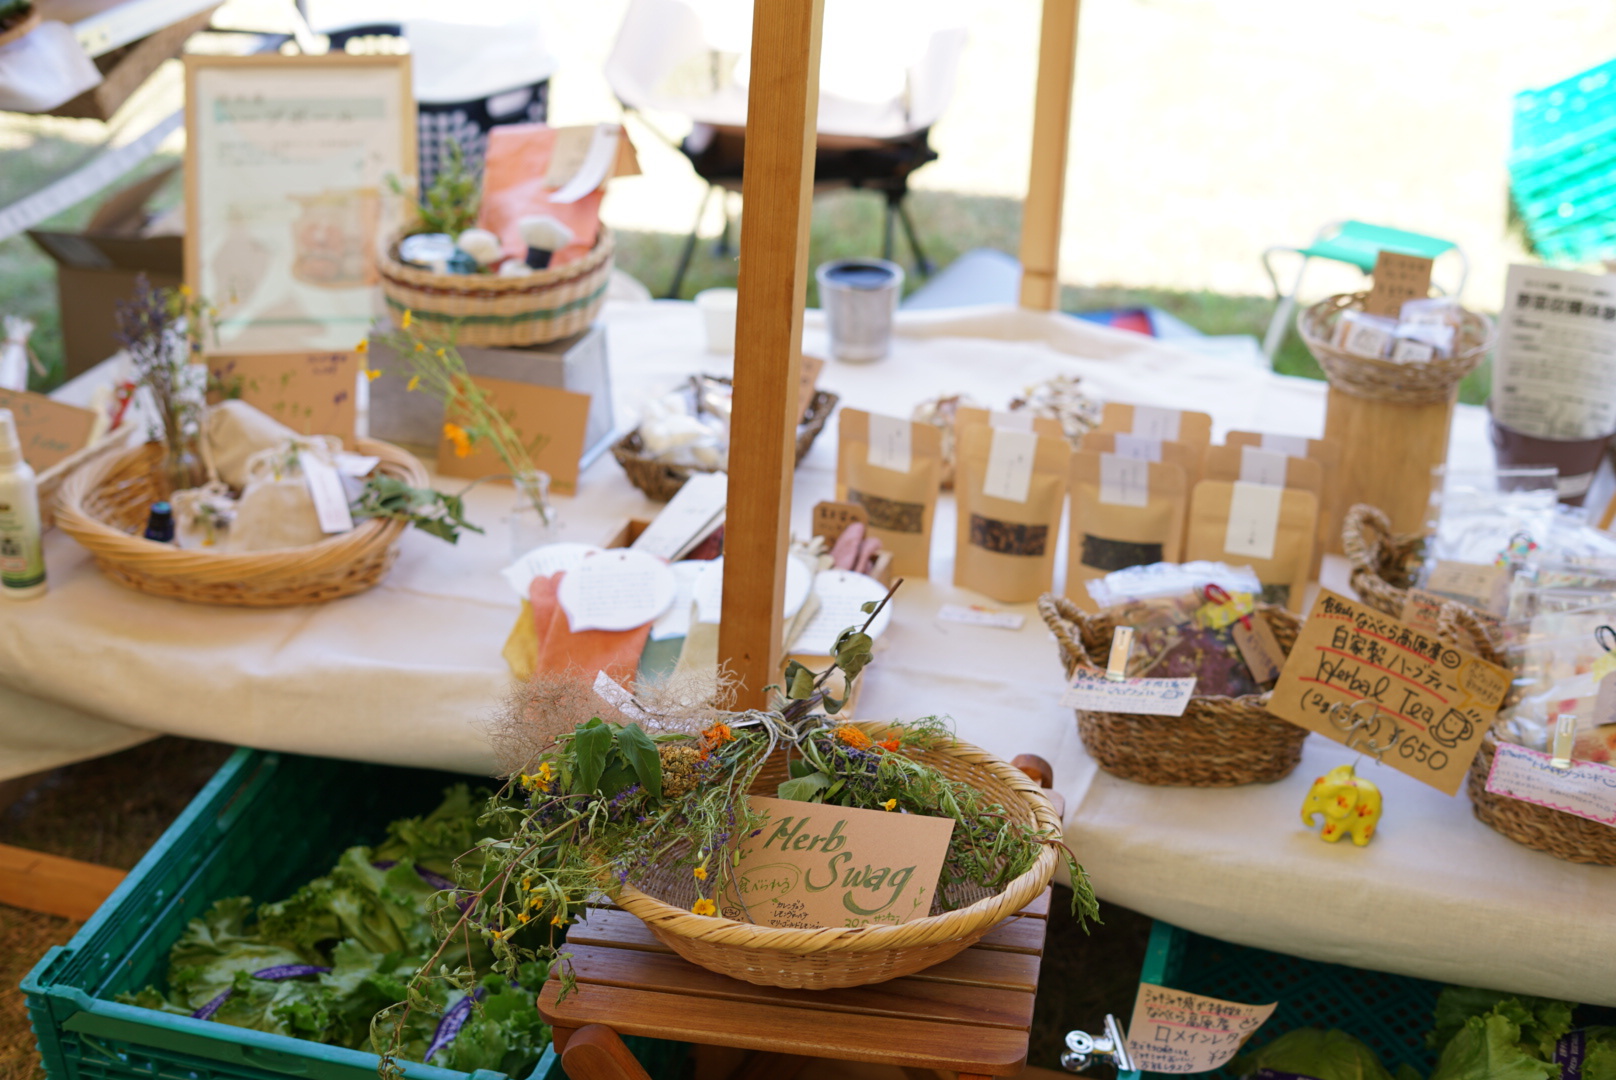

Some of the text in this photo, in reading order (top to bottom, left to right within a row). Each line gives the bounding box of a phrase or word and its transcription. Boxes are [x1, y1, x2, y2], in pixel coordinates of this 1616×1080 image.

[1315, 651, 1390, 703] Herbal
[1398, 687, 1434, 724] Tea
[763, 816, 848, 853] Herb
[804, 851, 918, 916] Swag
[1155, 1026, 1245, 1045] ロメインレタ
